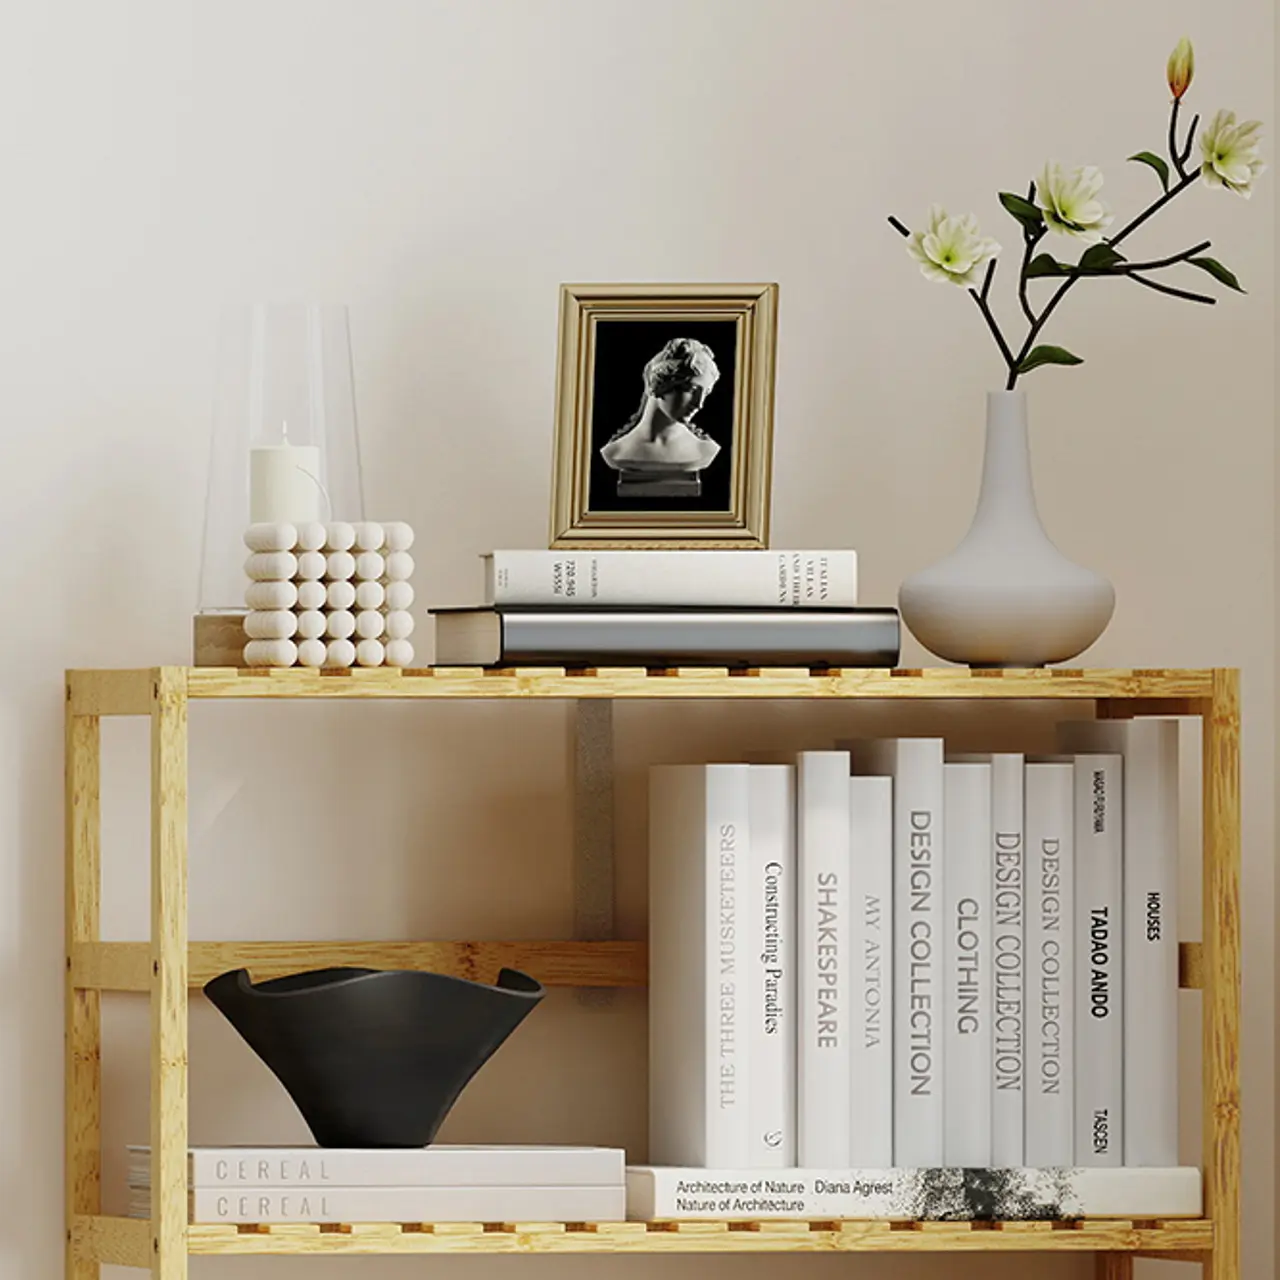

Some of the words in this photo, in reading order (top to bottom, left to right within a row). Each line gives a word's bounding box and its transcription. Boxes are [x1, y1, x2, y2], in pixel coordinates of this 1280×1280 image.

[719, 823, 736, 975] MUSKETEERS
[910, 810, 932, 912] DESIGN
[995, 832, 1021, 926] DESIGN
[1041, 838, 1060, 931] DESIGN
[761, 861, 784, 963] Constructing
[864, 894, 881, 930] MY
[1090, 906, 1109, 966] TADAO
[1146, 891, 1161, 942] HOUSES
[764, 967, 784, 1035] Paradies
[817, 872, 838, 1048] SHAKESPEARE
[864, 939, 881, 1049] ANTONIA
[957, 897, 979, 1035] CLOTHING
[1090, 967, 1109, 1019] ANDO
[719, 981, 736, 1058] THREE
[910, 920, 932, 1096] COLLECTION
[995, 934, 1022, 1091] COLLECTION
[1041, 939, 1060, 1094] COLLECTION
[719, 1063, 736, 1109] THE
[215, 1159, 331, 1181] CEREAL
[216, 1196, 331, 1218] CEREAL
[676, 1180, 747, 1195] Architecture
[749, 1180, 763, 1195] of
[764, 1180, 805, 1195] Nature
[814, 1179, 851, 1195] Diana
[852, 1179, 893, 1199] Agrest
[676, 1198, 717, 1213] Nature
[718, 1198, 731, 1213] of
[732, 1198, 805, 1213] Architecture
